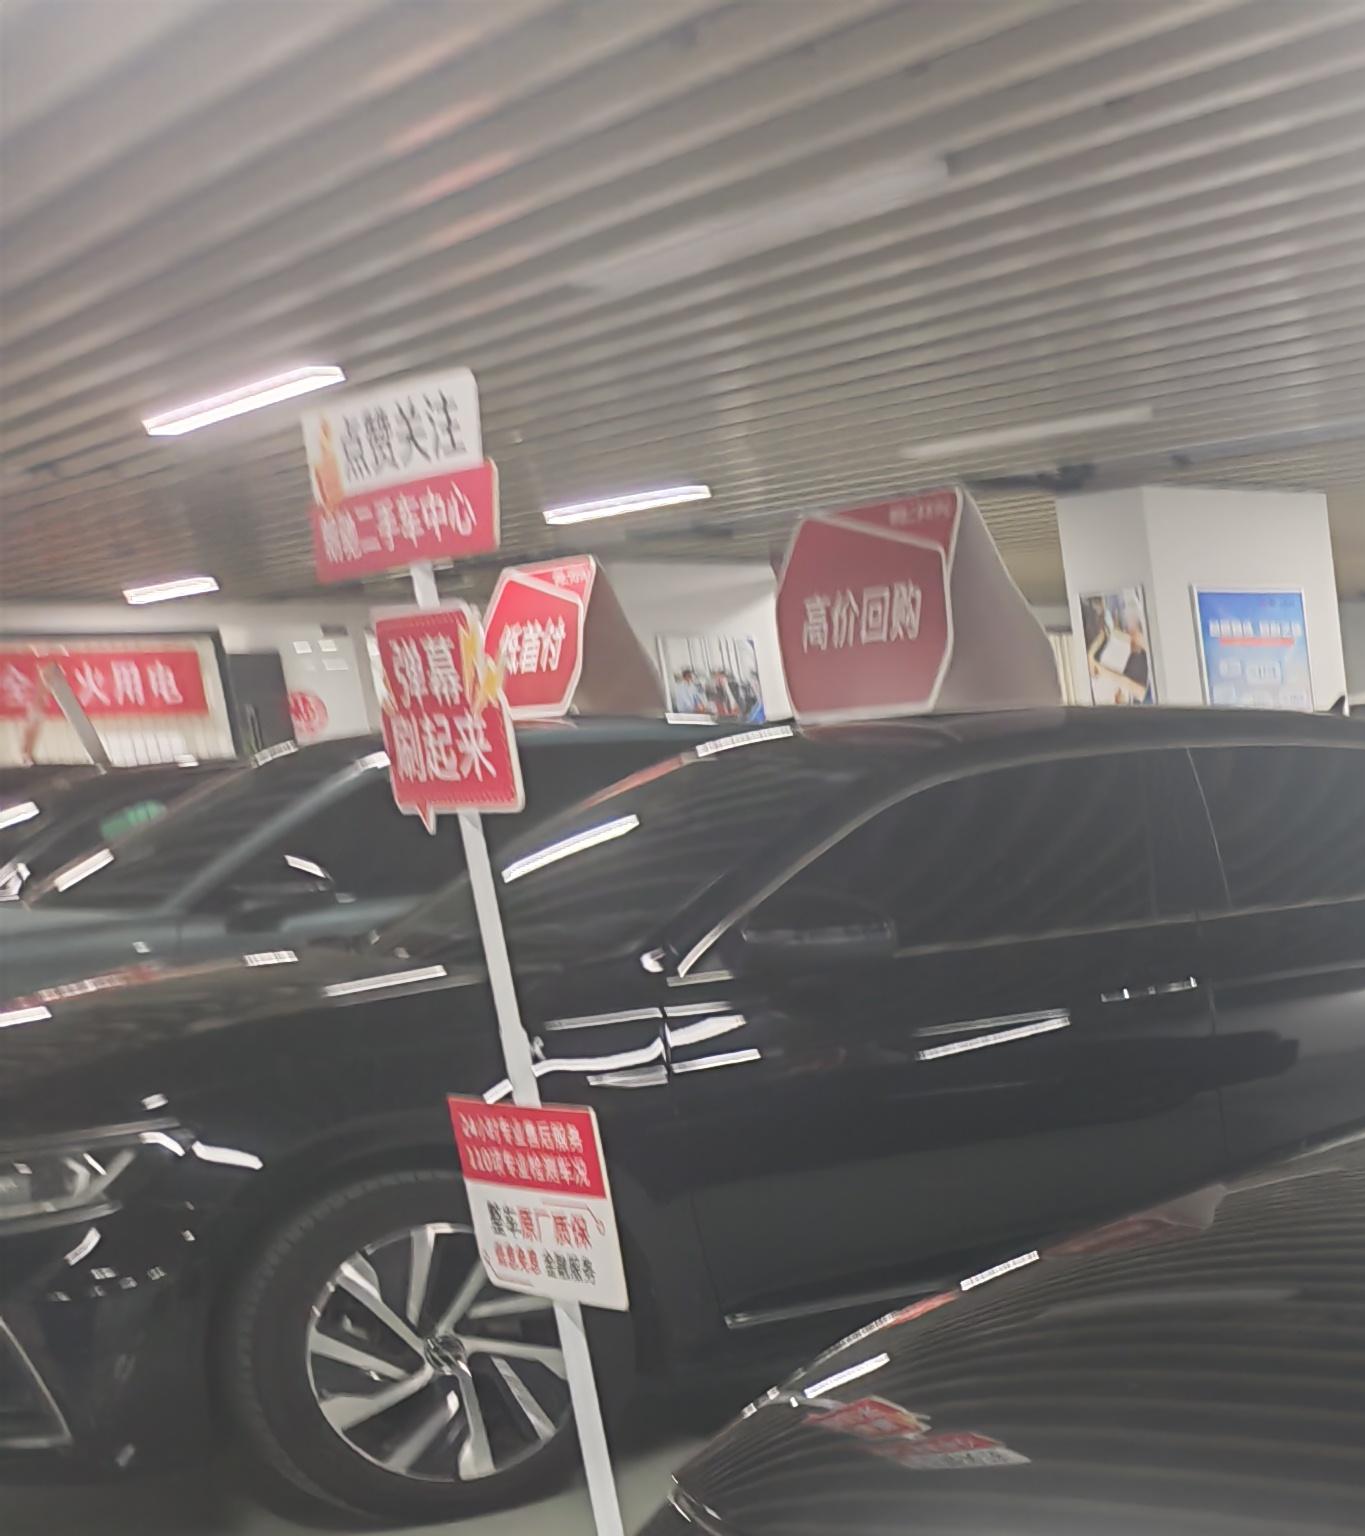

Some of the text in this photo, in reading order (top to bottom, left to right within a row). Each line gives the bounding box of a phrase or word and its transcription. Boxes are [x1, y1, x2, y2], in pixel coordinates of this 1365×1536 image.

[340, 388, 468, 482] 点赞关注
[501, 616, 566, 676] 低首付
[802, 578, 922, 653] 高价回购
[391, 708, 497, 783] 刷起来
